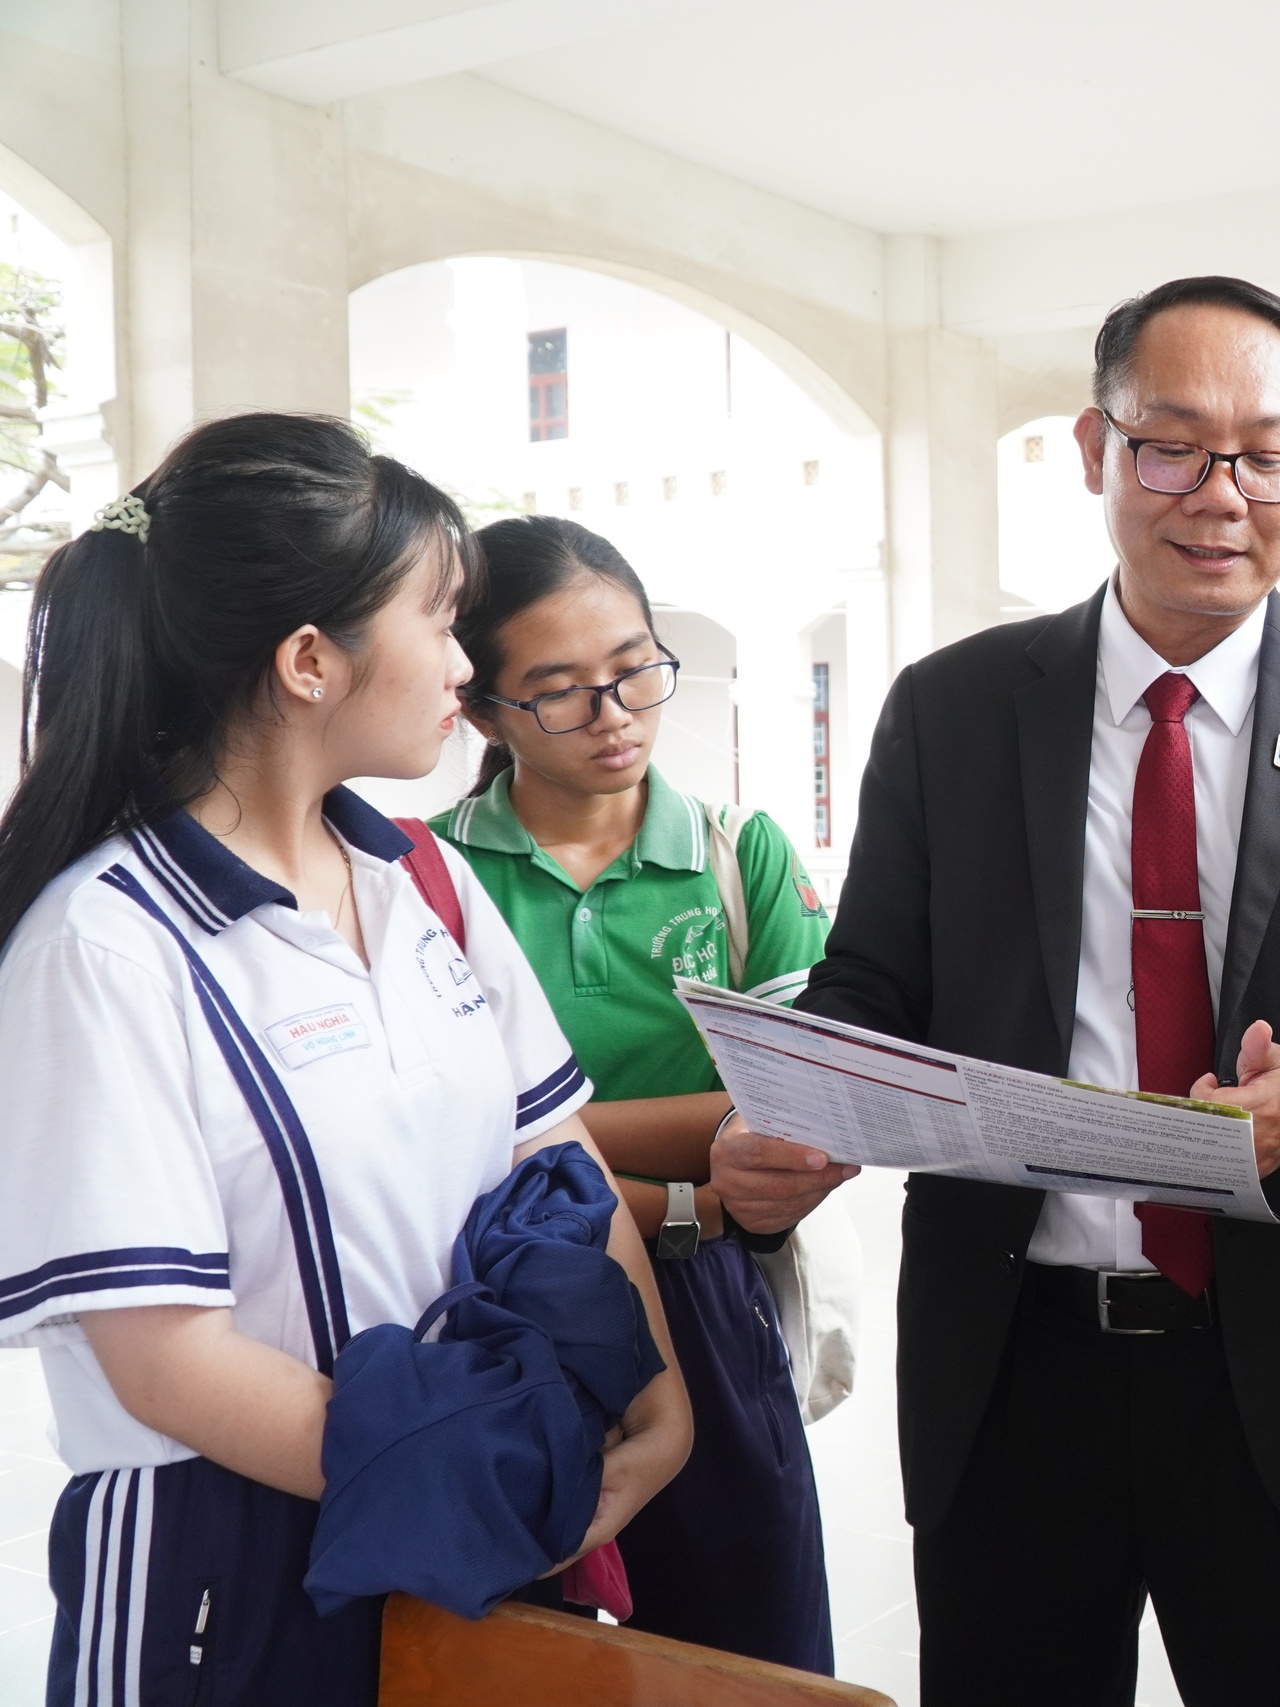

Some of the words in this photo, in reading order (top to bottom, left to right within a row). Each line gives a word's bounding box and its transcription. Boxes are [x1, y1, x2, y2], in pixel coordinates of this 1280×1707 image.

[651, 925, 672, 959] TRƯỜNG
[669, 907, 702, 926] TRUNG
[705, 906, 718, 917] HỌ
